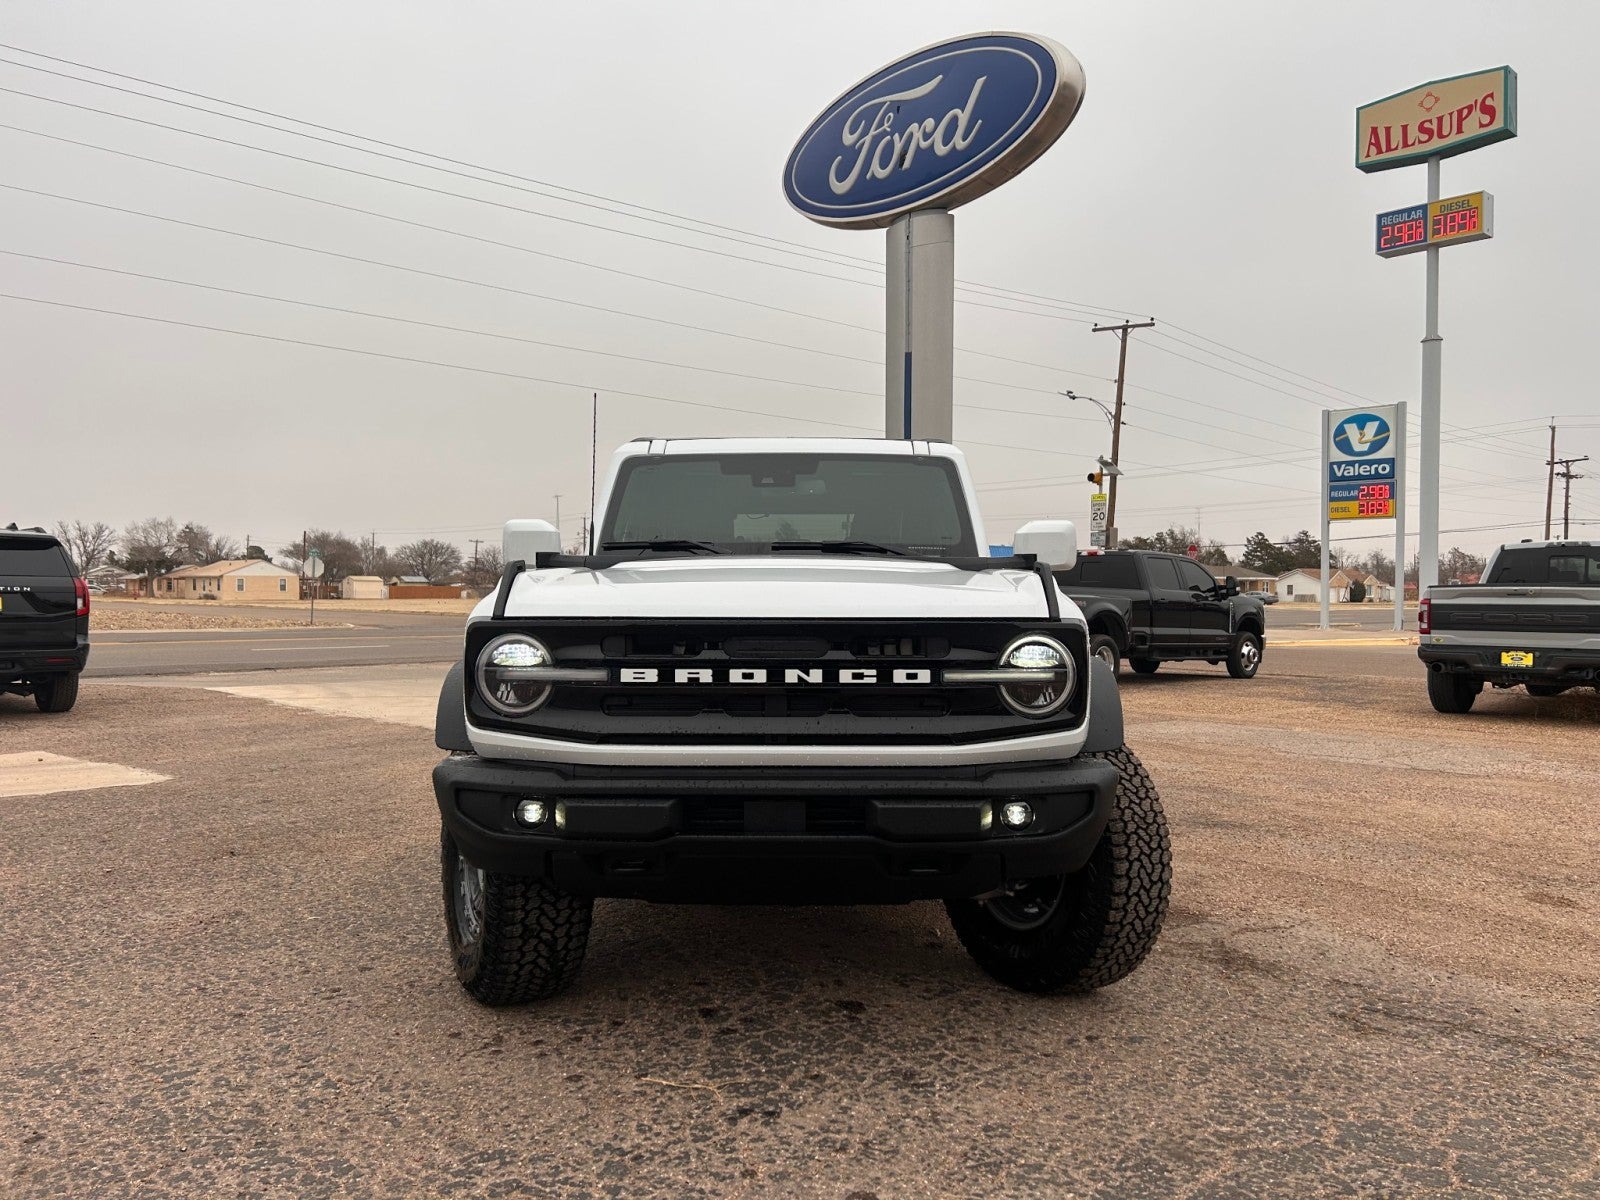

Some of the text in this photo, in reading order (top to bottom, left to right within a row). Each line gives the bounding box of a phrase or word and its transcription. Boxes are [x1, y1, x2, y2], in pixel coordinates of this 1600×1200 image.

[1364, 91, 1497, 159] ALLSUP'S
[828, 74, 987, 195] Ford
[1439, 199, 1473, 214] DIESEL
[1381, 210, 1423, 226] REGULAR
[1333, 463, 1390, 477] Valero
[1331, 490, 1359, 498] REGULAR
[1093, 512, 1105, 520] 20
[1330, 506, 1351, 514] DIESEL
[620, 668, 931, 683] BRONCO
